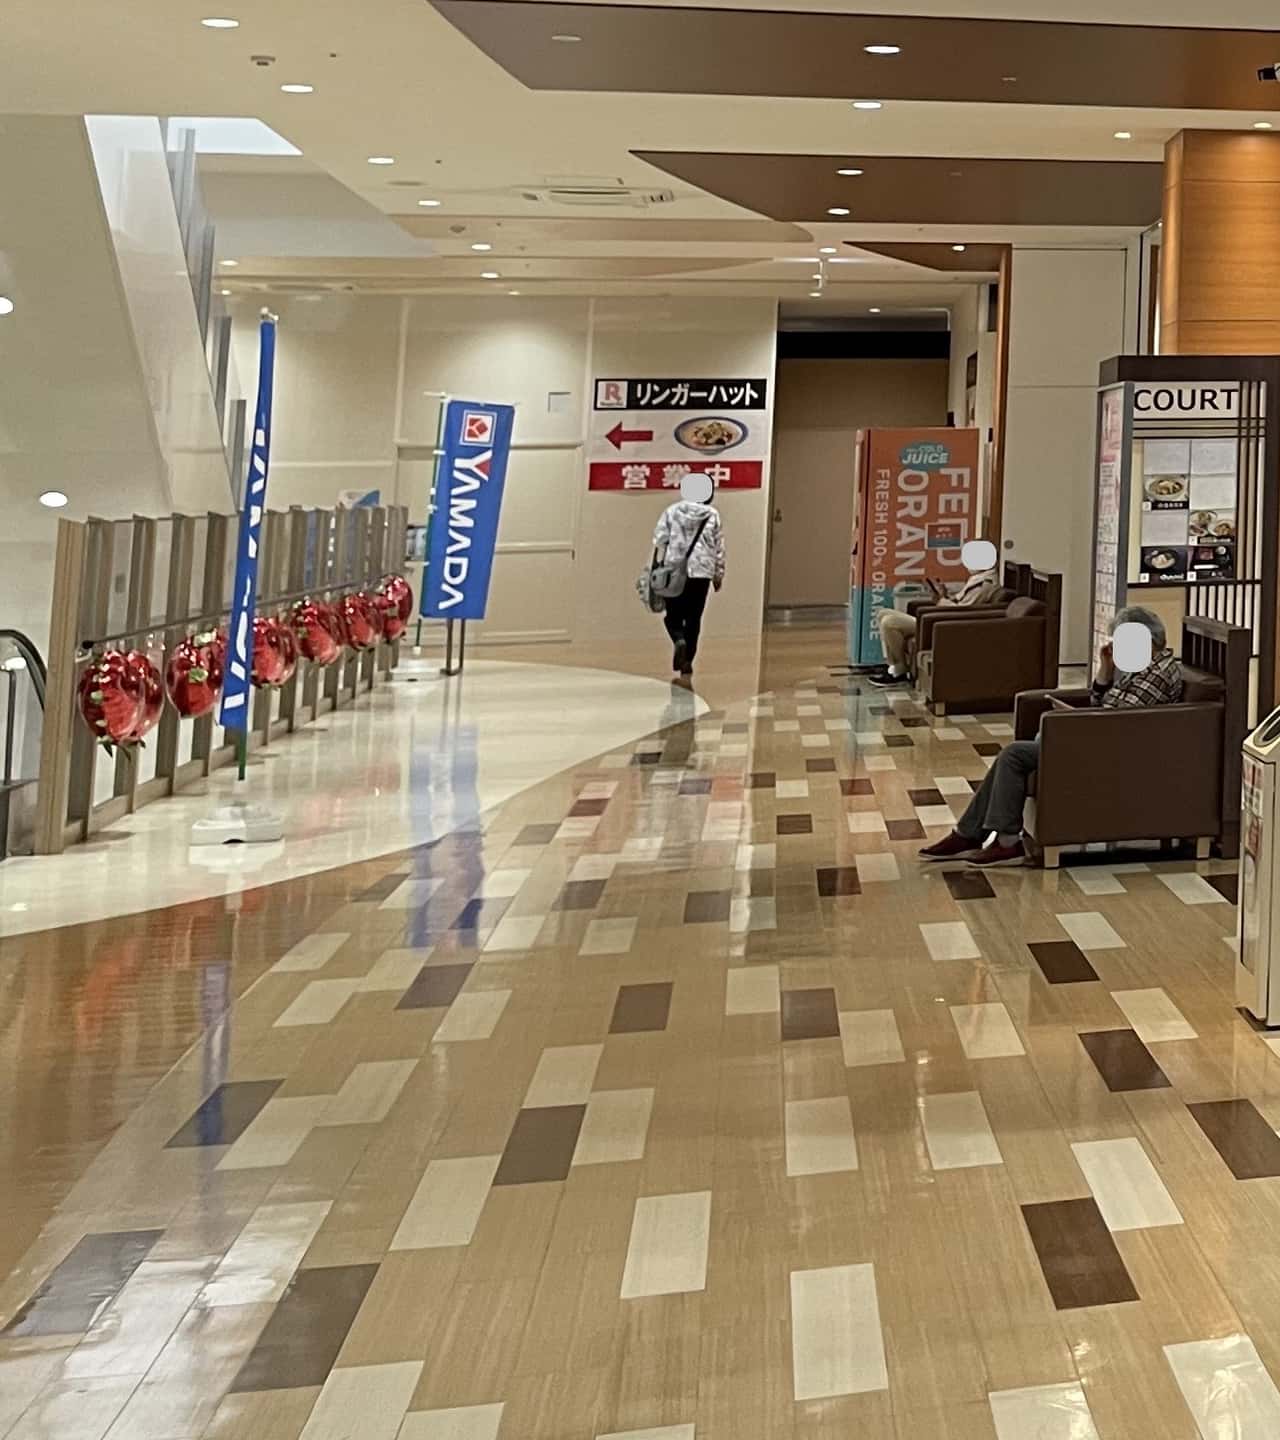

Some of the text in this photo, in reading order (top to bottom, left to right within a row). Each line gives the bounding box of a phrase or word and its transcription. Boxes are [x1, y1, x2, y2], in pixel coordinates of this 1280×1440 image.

[636, 382, 759, 406] リンガーハット
[1134, 389, 1239, 411] COURT
[902, 451, 949, 464] JUICE
[875, 468, 891, 524] FRESH
[438, 448, 493, 610] YAMADA
